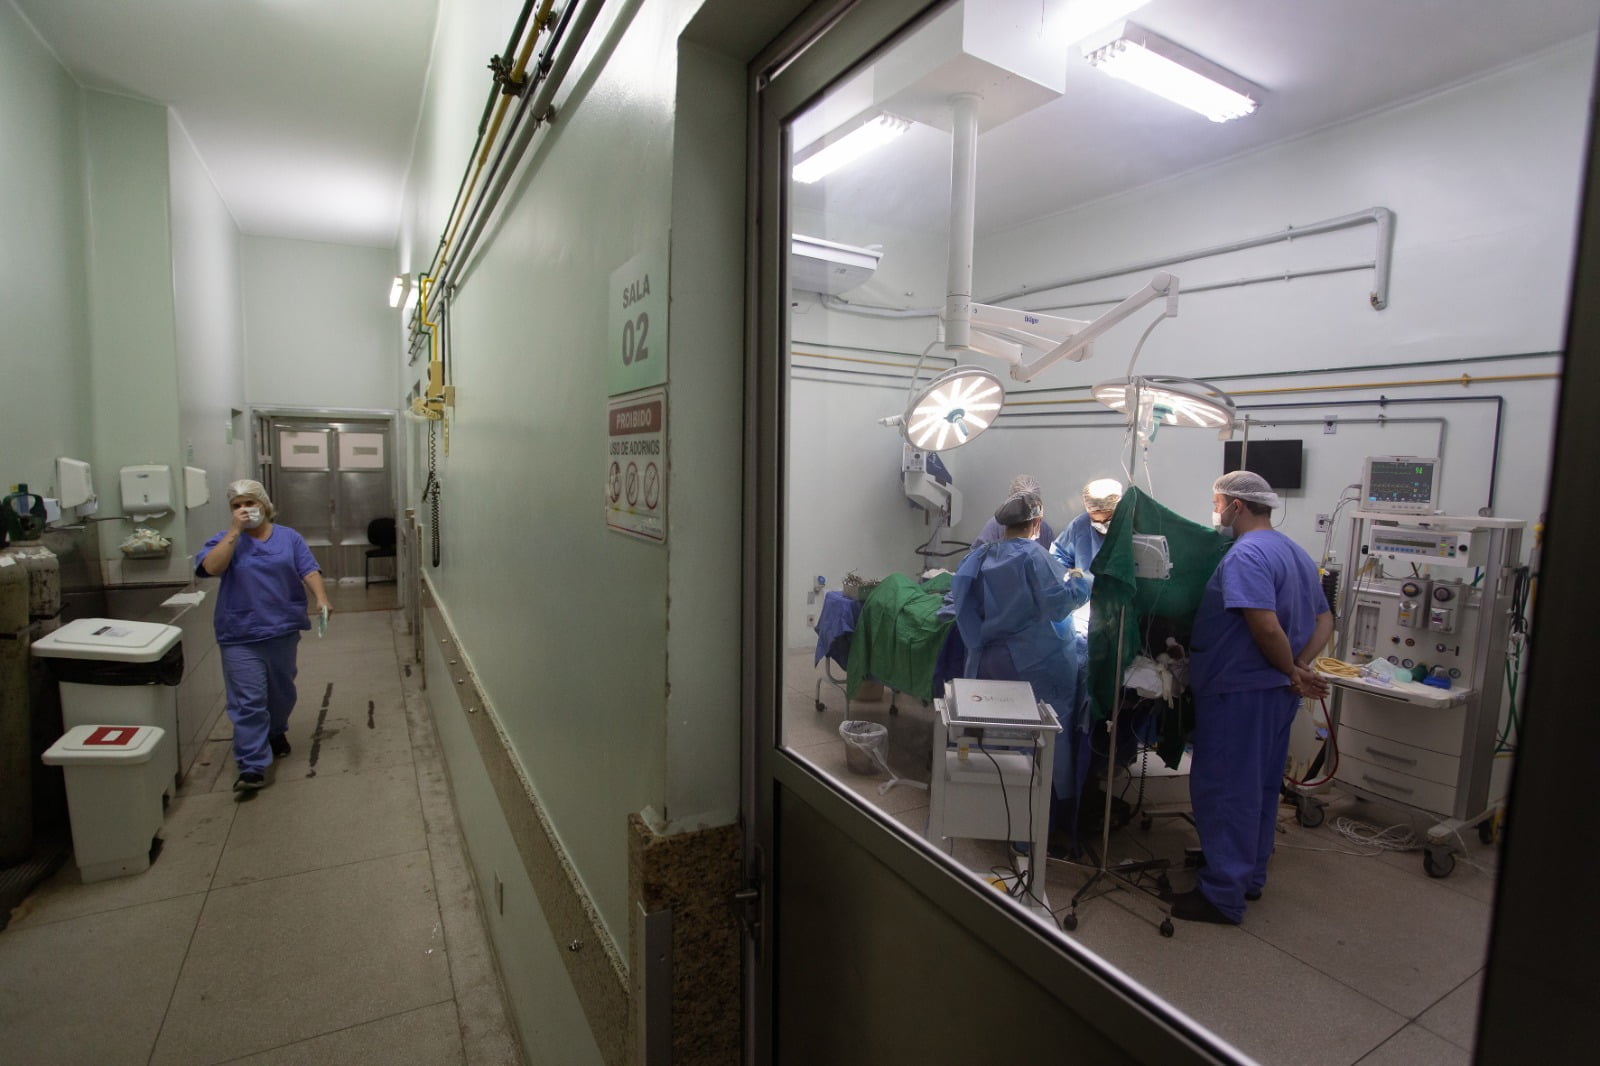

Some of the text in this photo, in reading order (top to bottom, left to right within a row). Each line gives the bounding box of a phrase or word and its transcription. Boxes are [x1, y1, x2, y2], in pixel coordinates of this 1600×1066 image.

[622, 273, 650, 309] SALA
[622, 311, 649, 366] 02
[616, 407, 652, 430] PROIBIDO
[629, 439, 660, 456] ADORNOS
